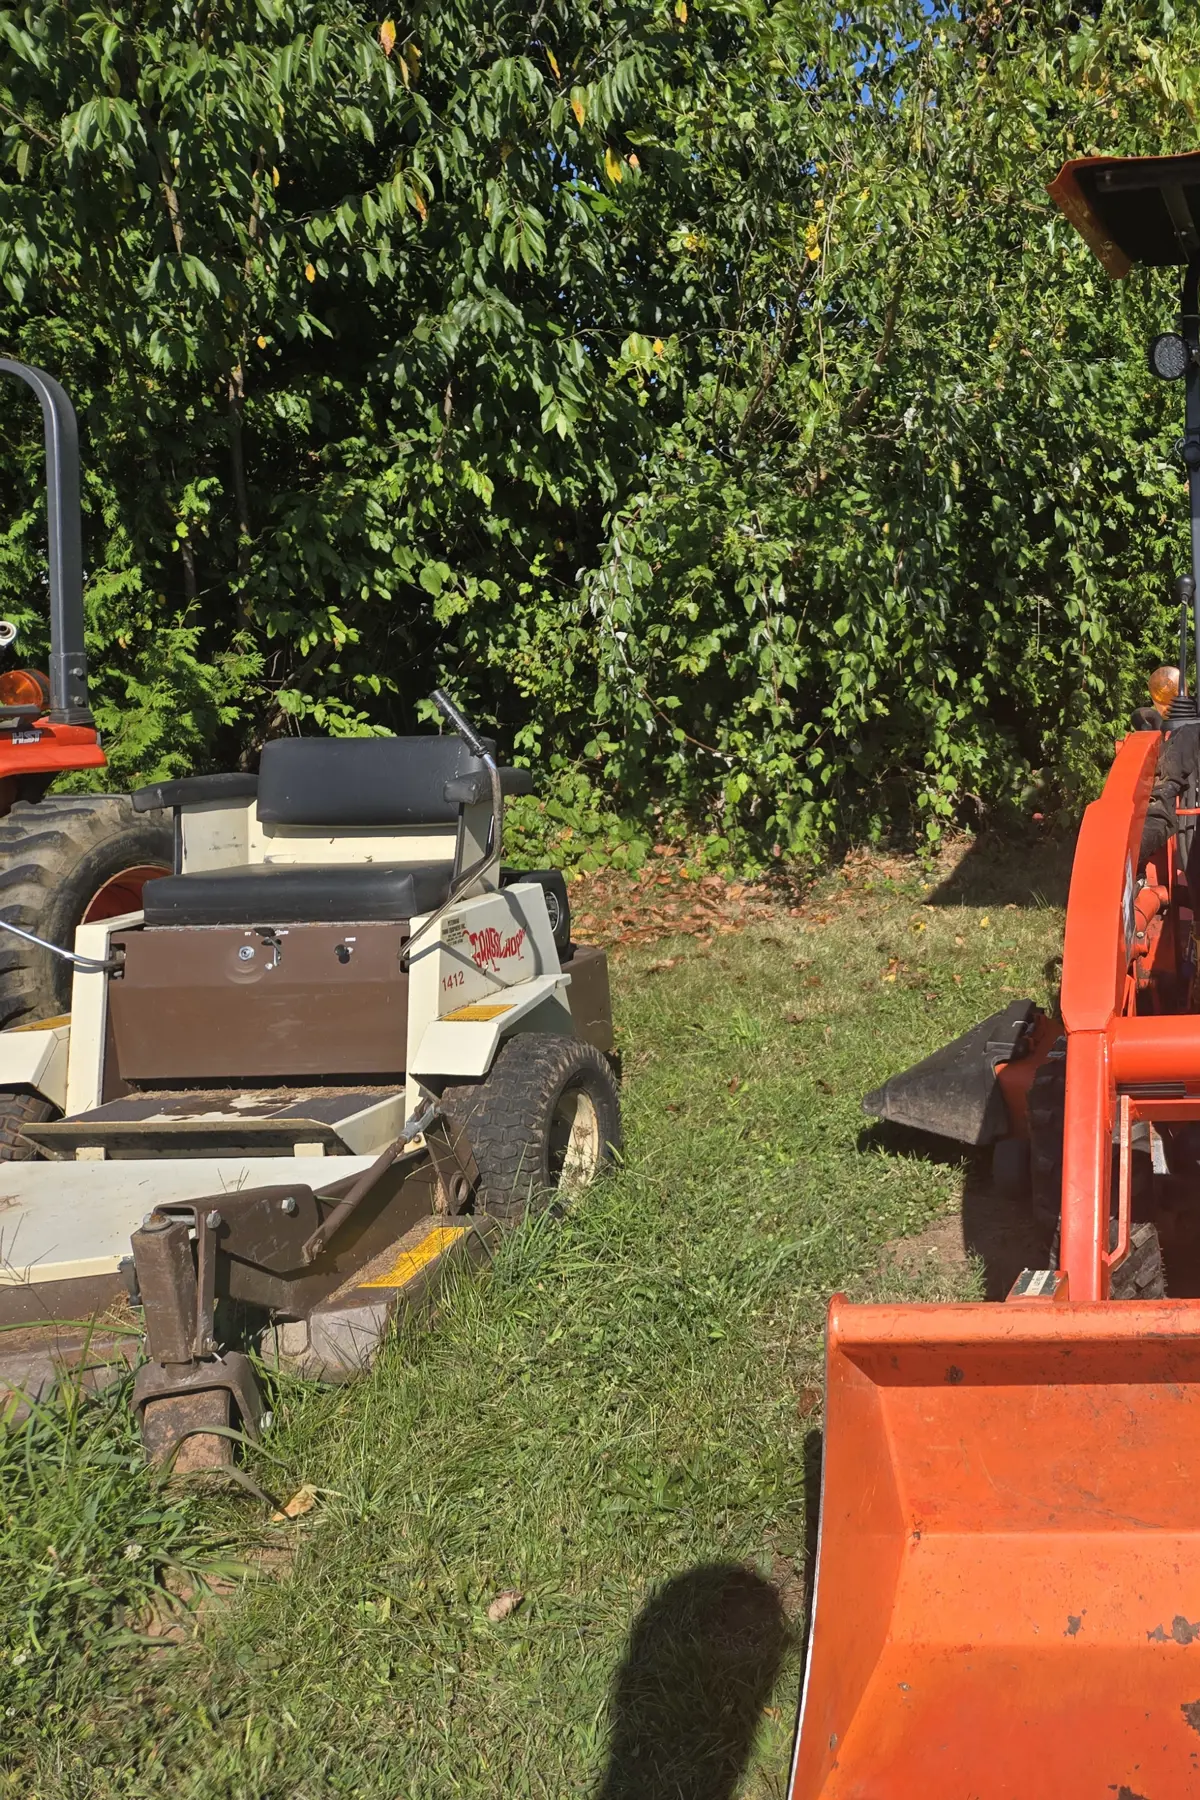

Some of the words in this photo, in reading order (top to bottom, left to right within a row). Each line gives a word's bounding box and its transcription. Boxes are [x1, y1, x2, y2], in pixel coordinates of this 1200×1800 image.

[12, 730, 42, 745] HST
[468, 926, 527, 969] GRASSHOP
[442, 970, 465, 991] 1412
